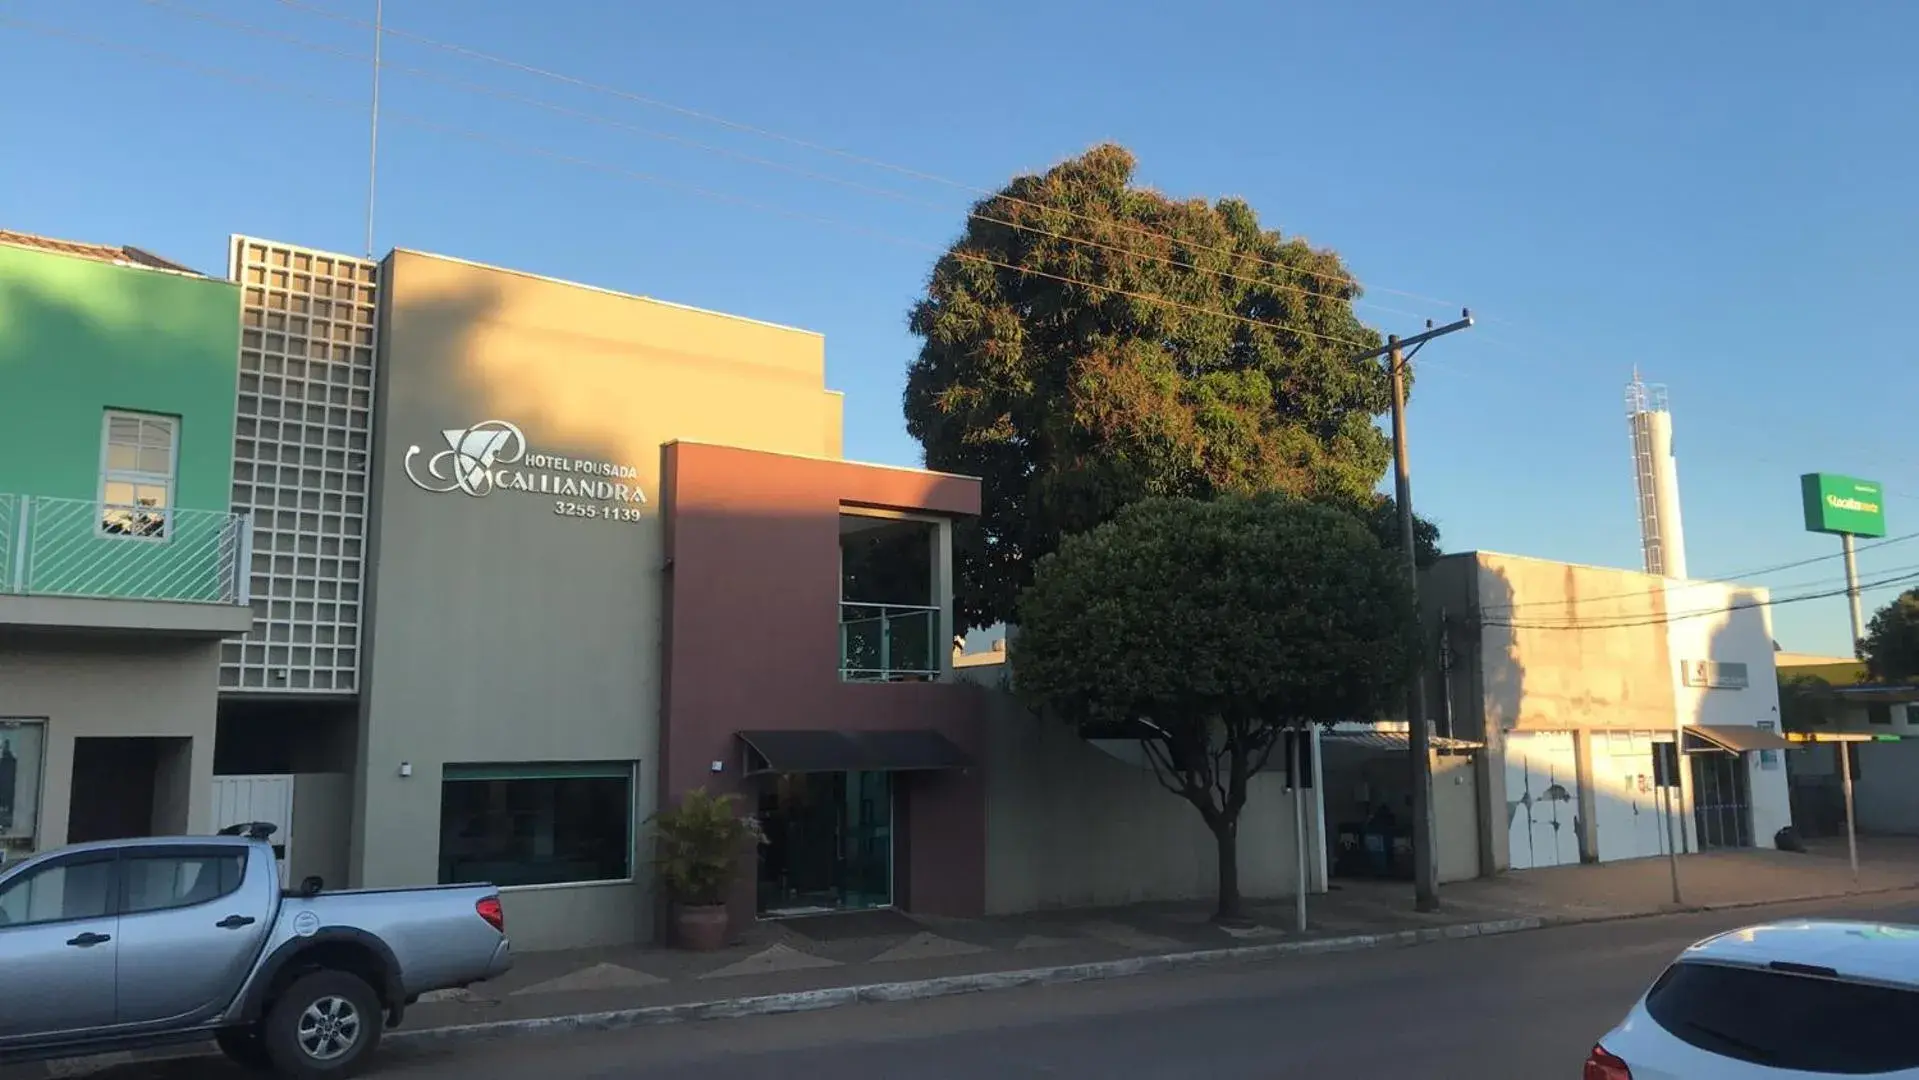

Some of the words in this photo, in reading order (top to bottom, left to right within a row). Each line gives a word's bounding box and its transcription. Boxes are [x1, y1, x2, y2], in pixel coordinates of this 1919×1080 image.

[525, 453, 571, 471] HOTEL
[574, 460, 637, 479] POUSADA
[495, 470, 648, 503] CALLIANDRA
[555, 501, 640, 522] 3255-1139
